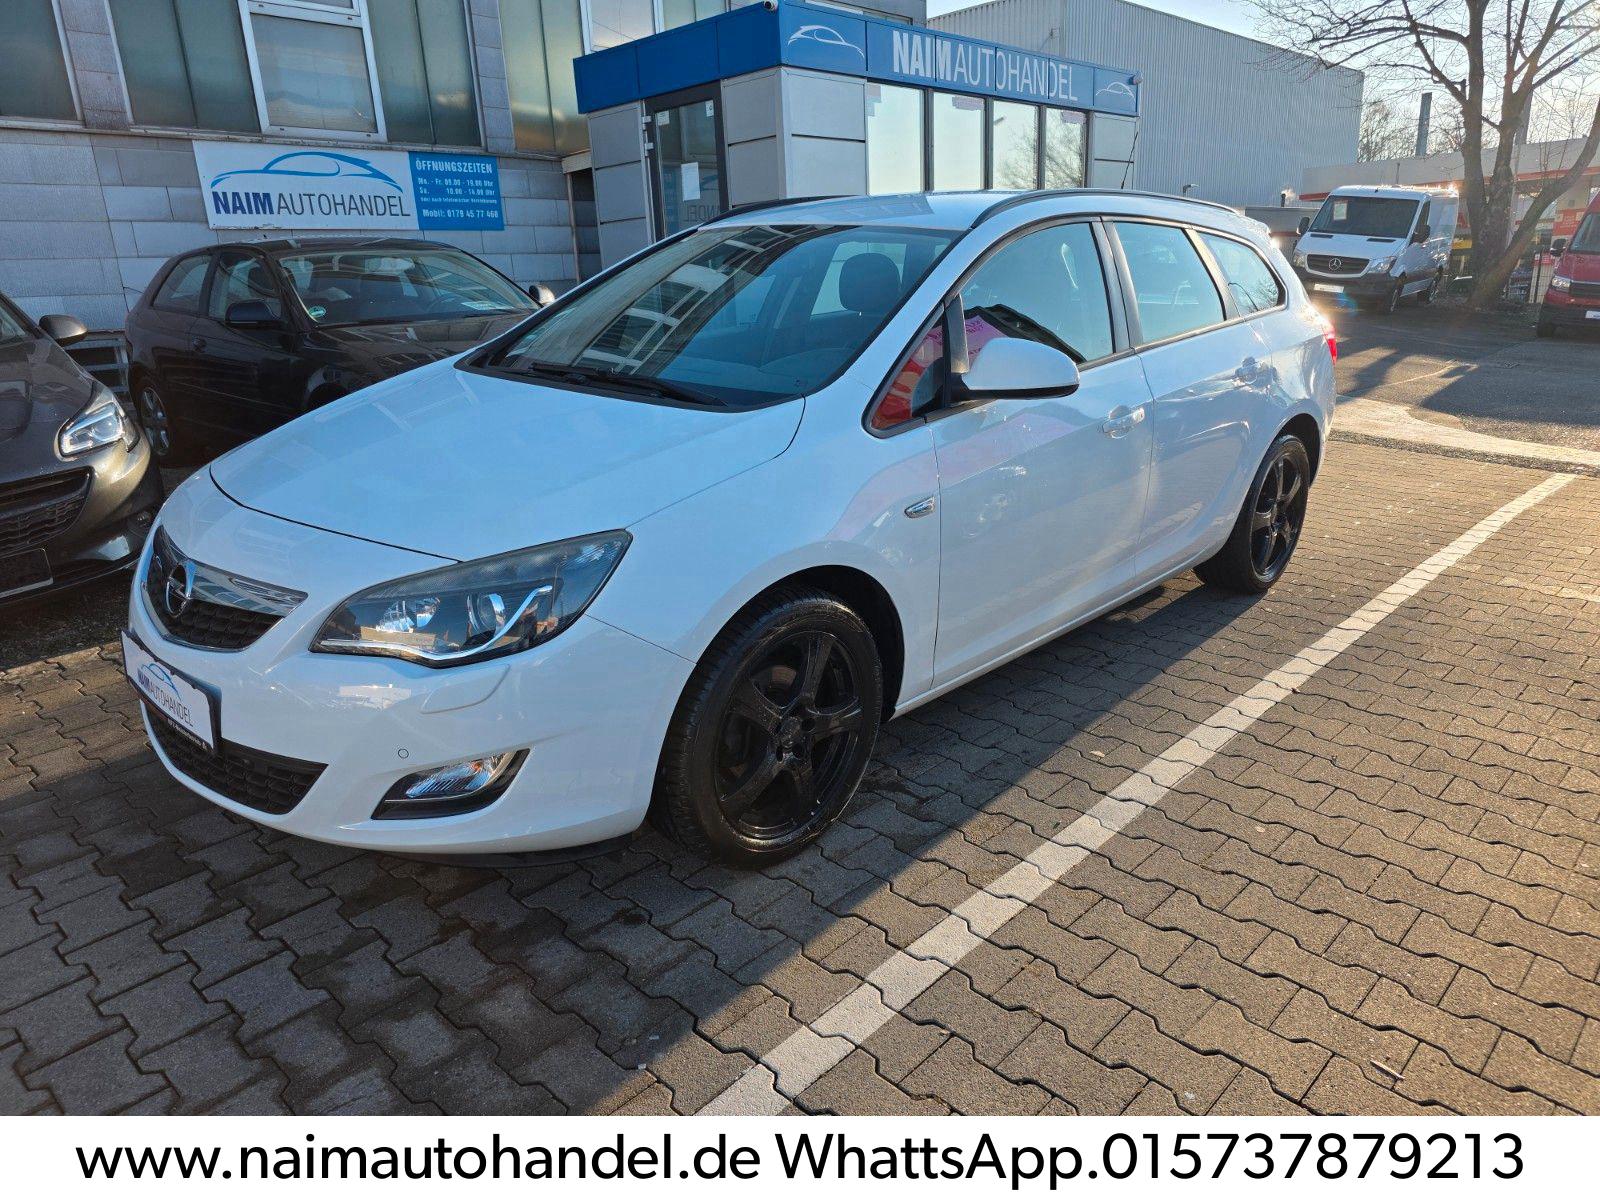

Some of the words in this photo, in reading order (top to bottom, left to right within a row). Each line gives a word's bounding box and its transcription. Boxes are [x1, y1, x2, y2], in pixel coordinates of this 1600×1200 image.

[892, 30, 951, 80] NAIM
[953, 43, 1078, 102] AUTOHANDEL
[415, 158, 493, 174] ÖFFNUNGSZEITEN
[211, 191, 274, 215] NAIM
[277, 193, 410, 217] AUTOHANDEL
[422, 209, 445, 217] Mobil:
[447, 209, 464, 217] 0179
[466, 210, 475, 218] 45
[476, 210, 485, 219] 77
[149, 680, 194, 728] AUTOHANDEL
